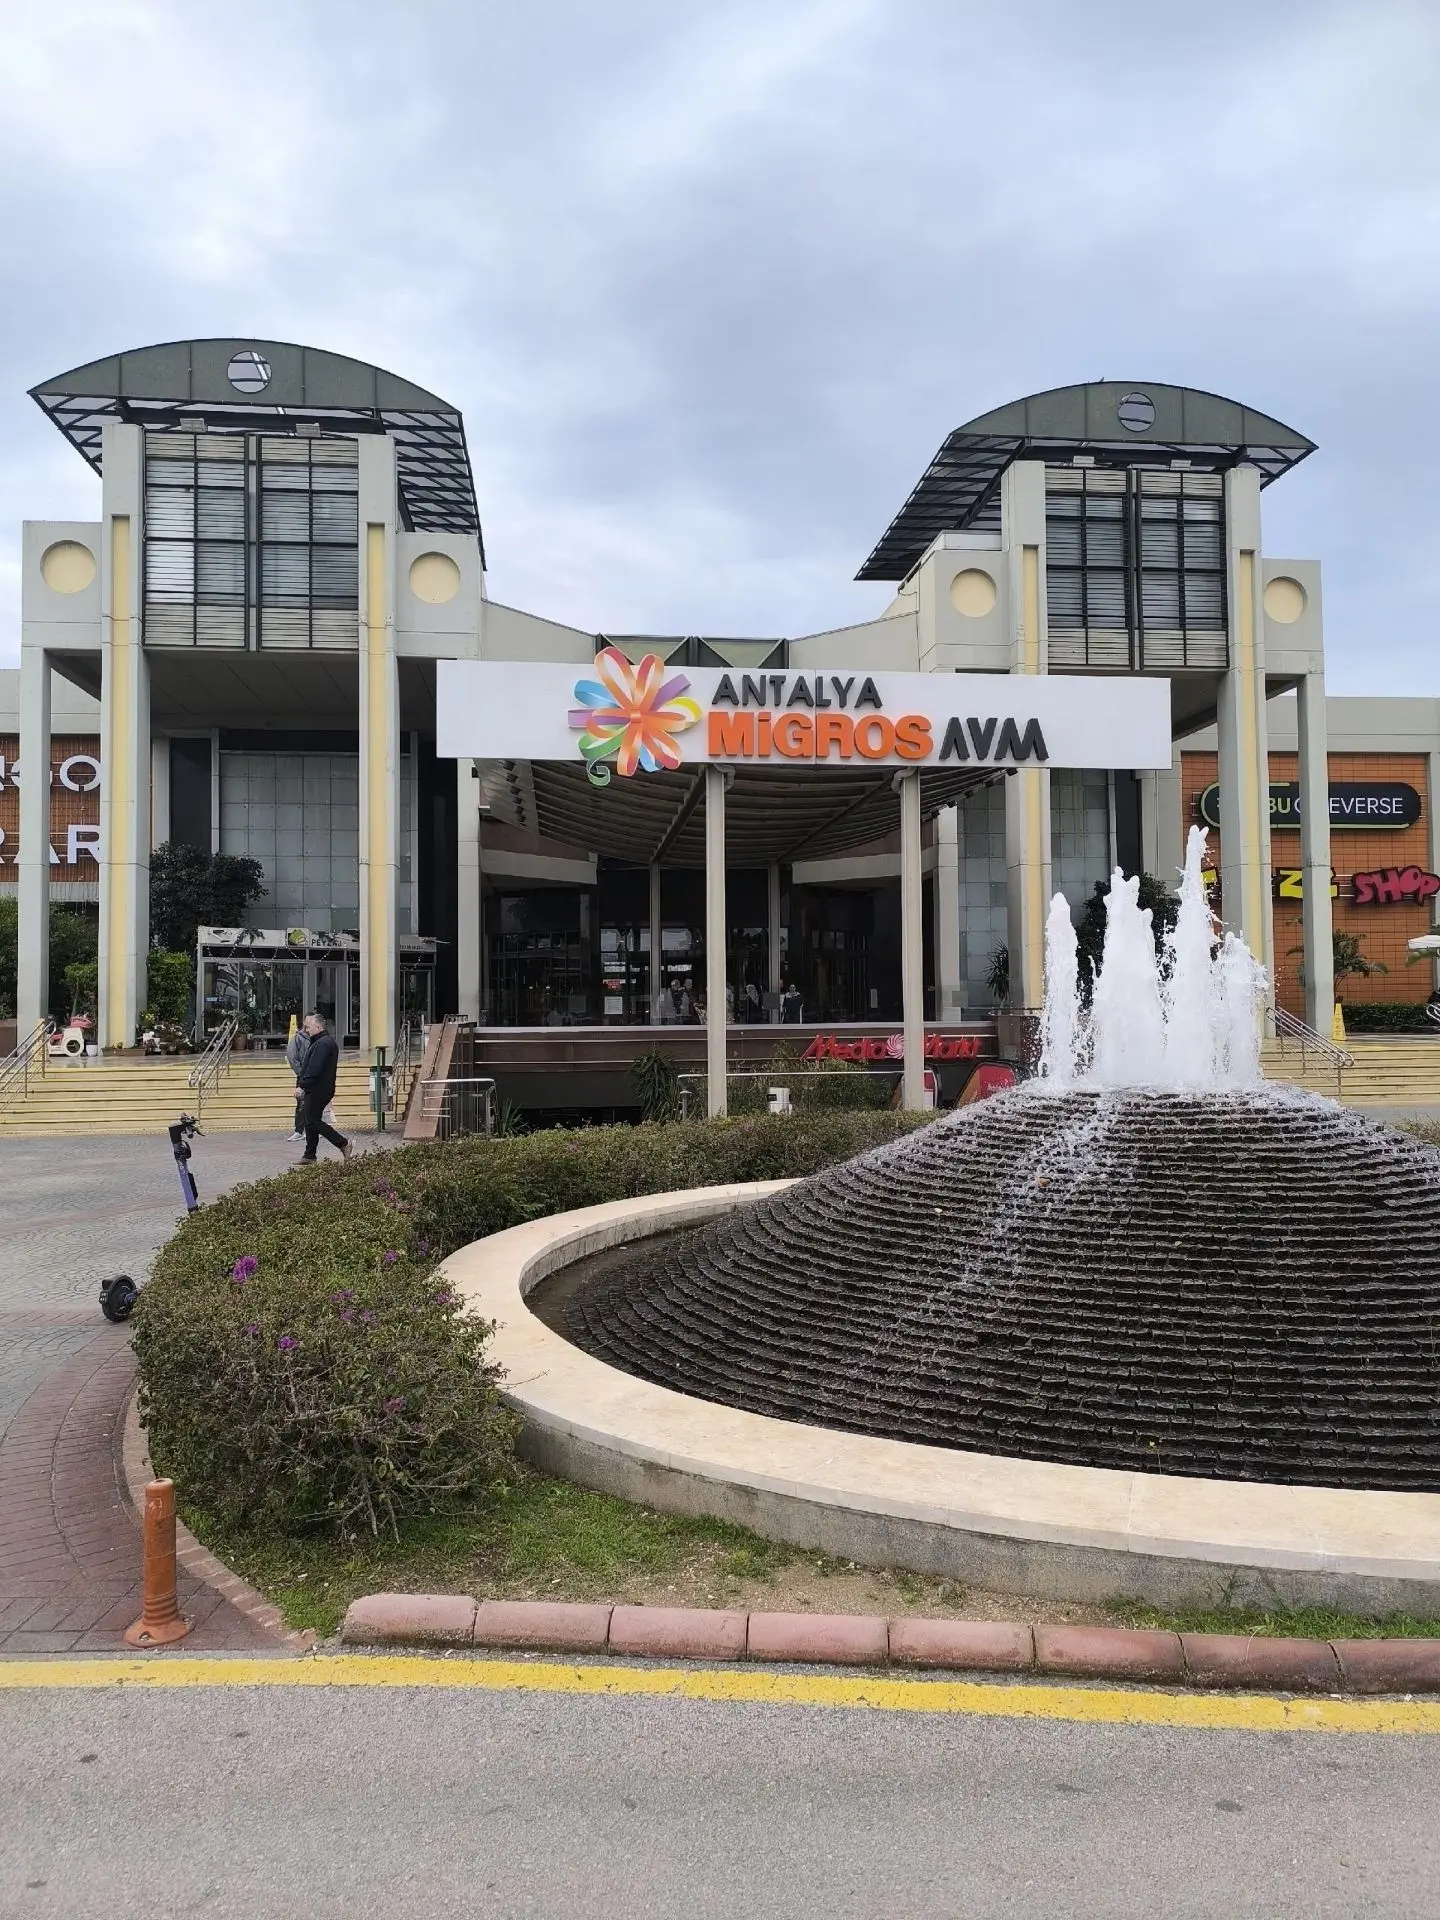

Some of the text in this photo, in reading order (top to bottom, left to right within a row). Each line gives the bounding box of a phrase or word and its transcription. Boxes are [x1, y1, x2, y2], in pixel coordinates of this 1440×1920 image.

[712, 673, 883, 708] ANTALYA
[708, 711, 1049, 761] MiGROS AVM
[1354, 866, 1440, 906] SHOP
[800, 1032, 886, 1061] Media
